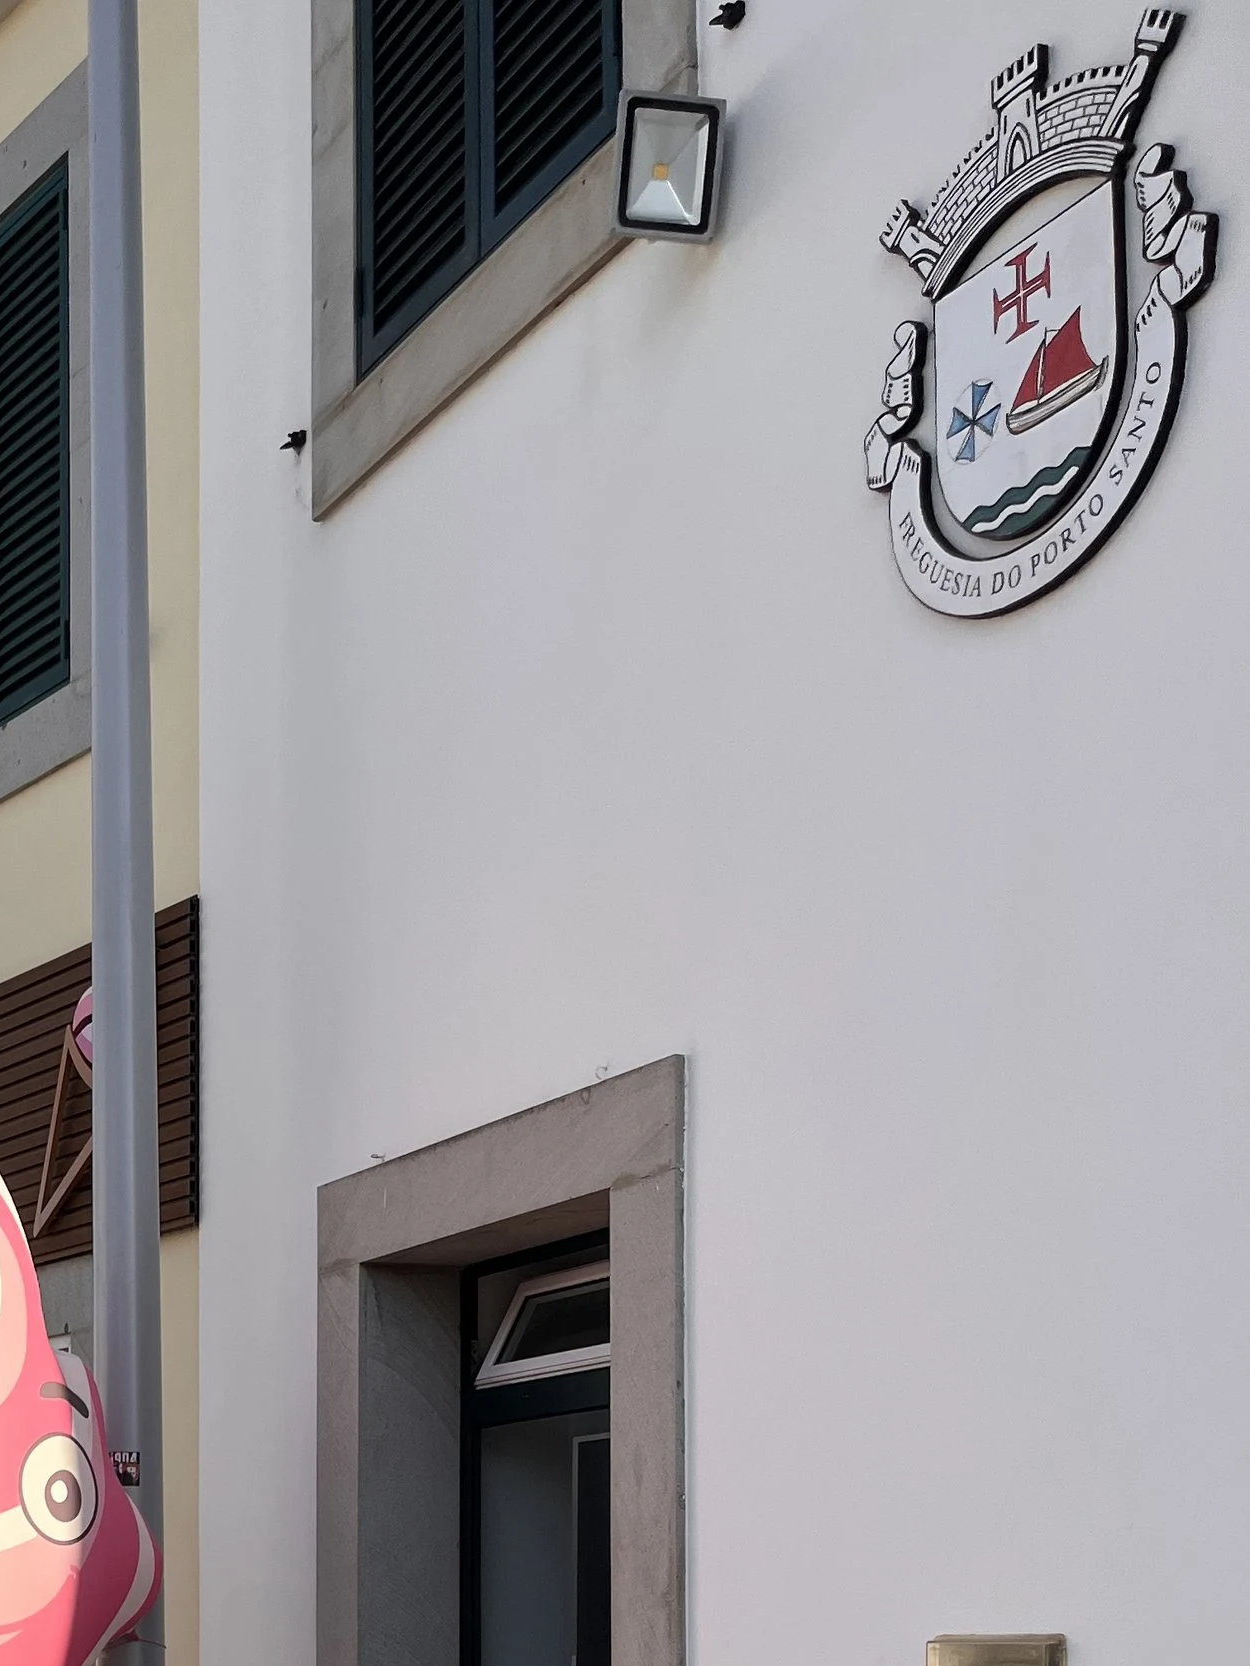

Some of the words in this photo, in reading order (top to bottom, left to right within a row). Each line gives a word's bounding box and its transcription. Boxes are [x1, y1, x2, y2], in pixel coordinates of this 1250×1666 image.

[899, 511, 982, 597] FREGUESIA
[991, 565, 1022, 595] DO
[1030, 494, 1104, 578] PORTO
[1108, 361, 1162, 486] SANTO
